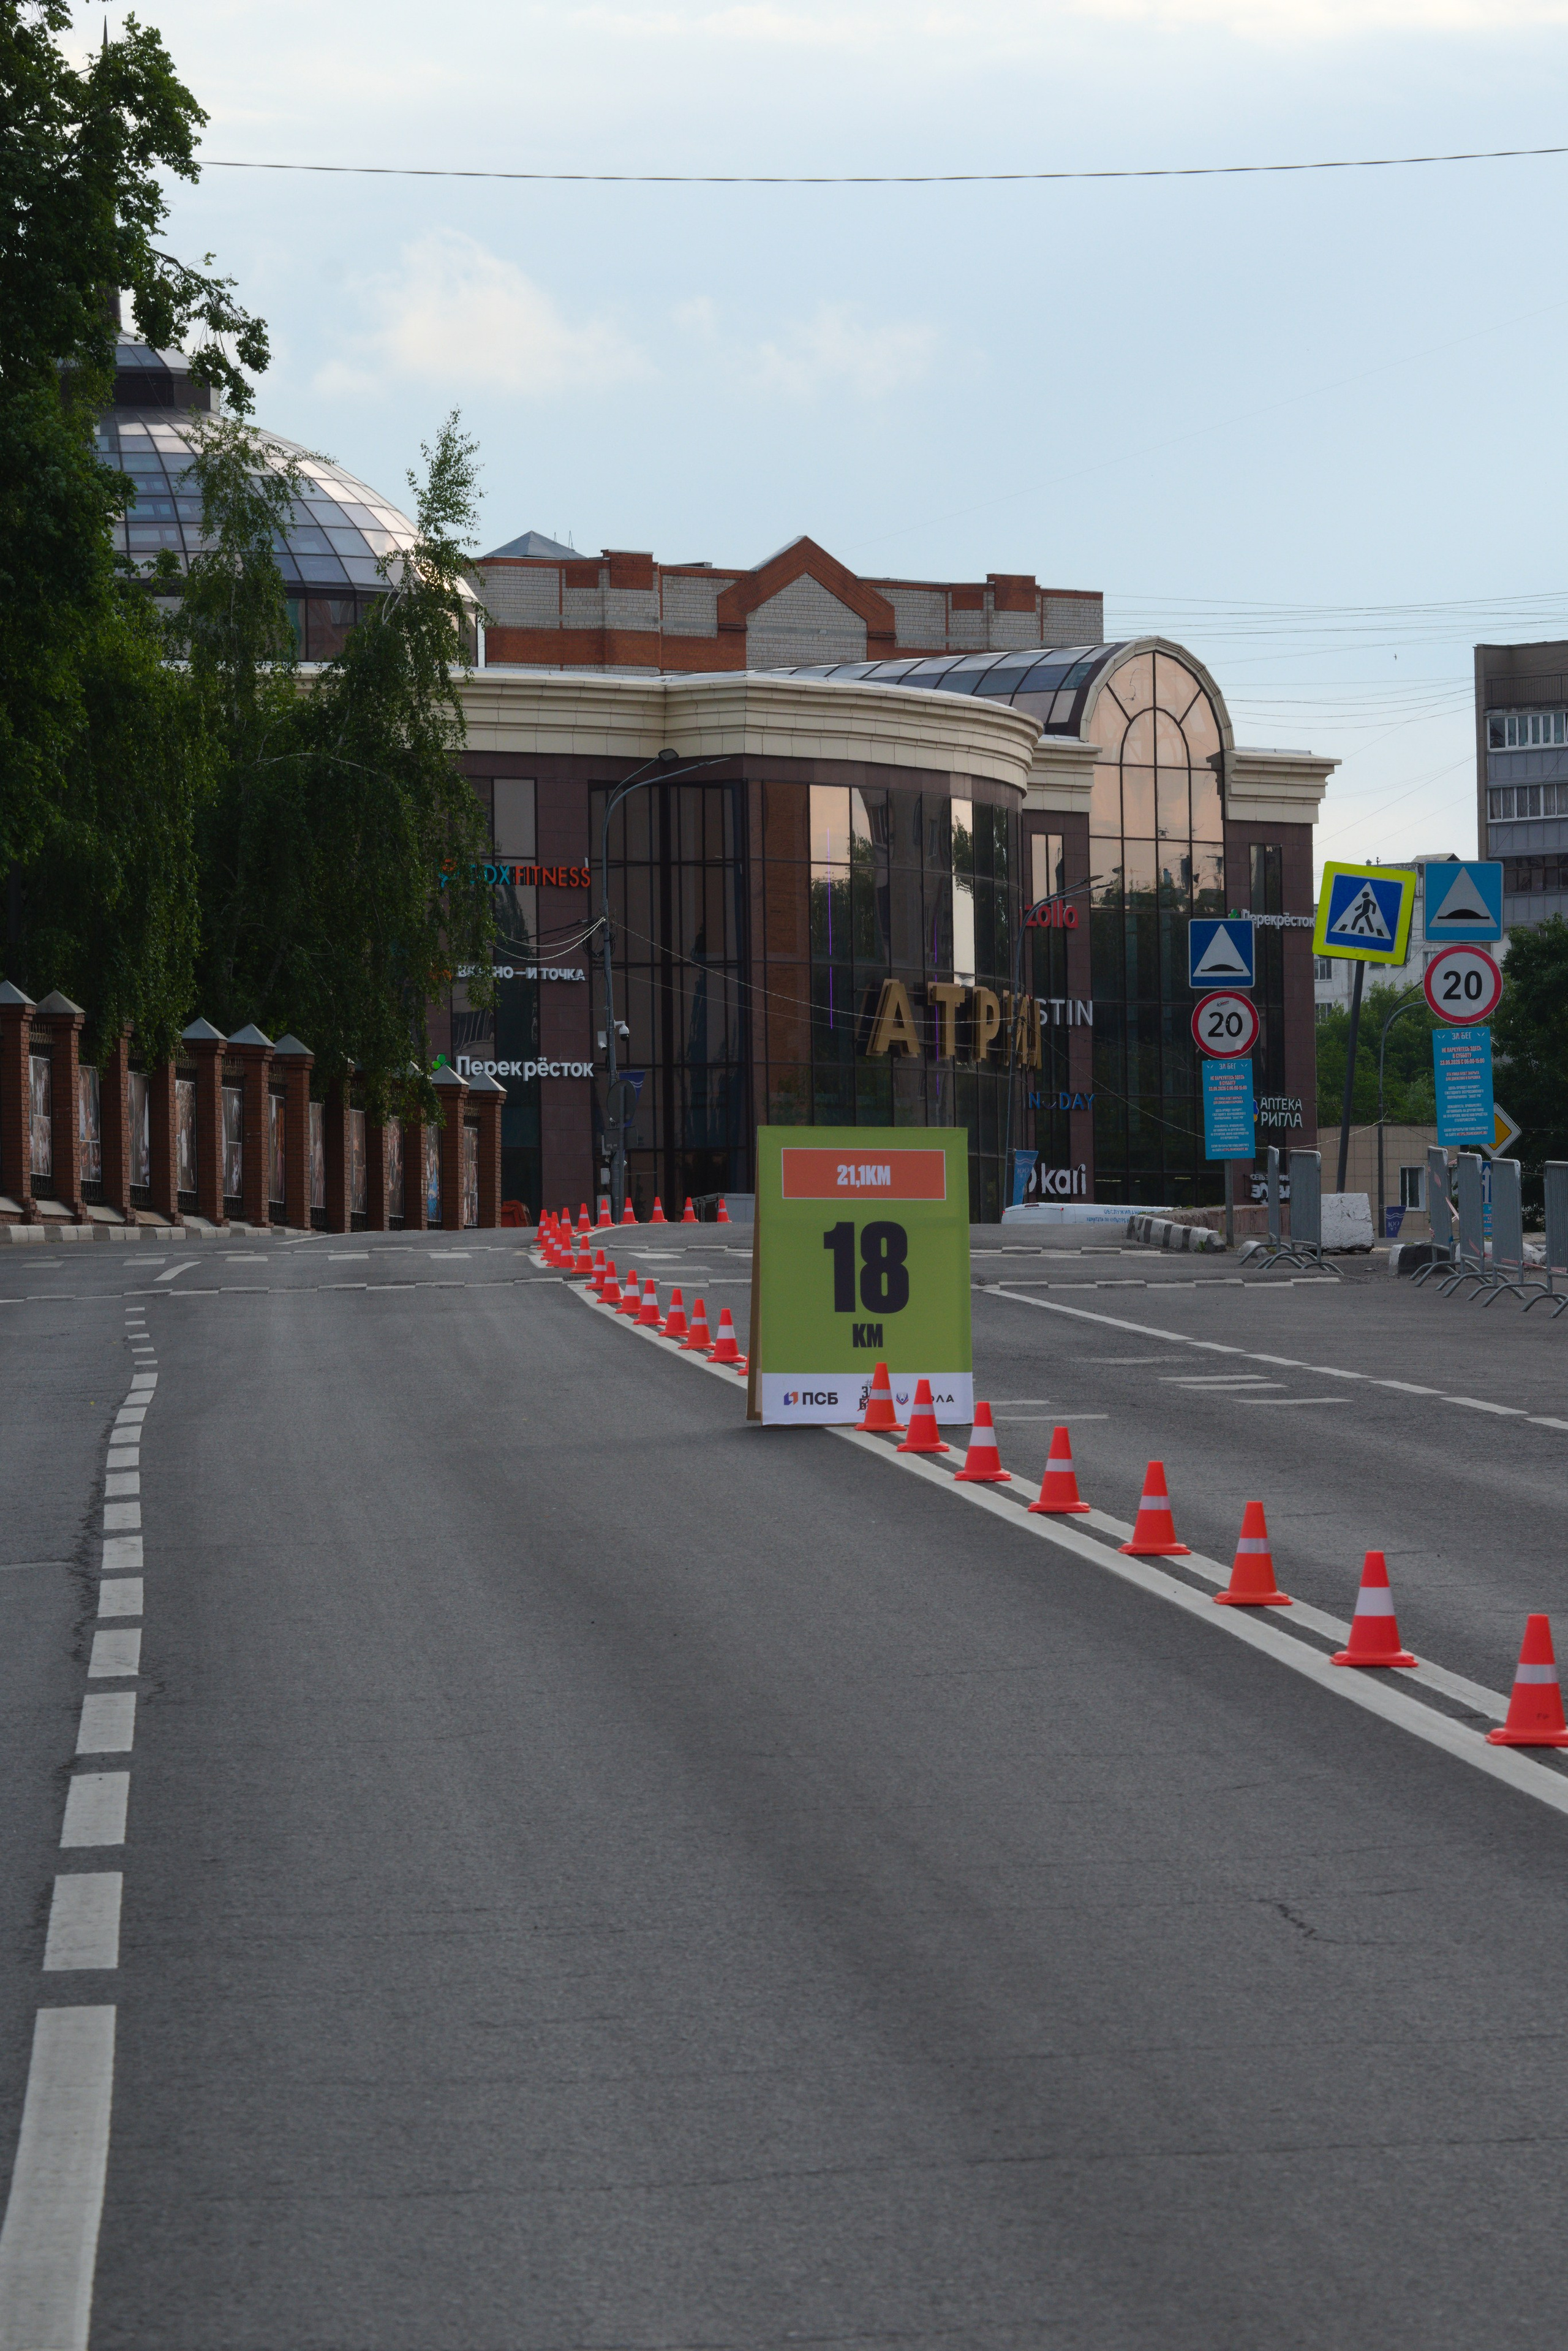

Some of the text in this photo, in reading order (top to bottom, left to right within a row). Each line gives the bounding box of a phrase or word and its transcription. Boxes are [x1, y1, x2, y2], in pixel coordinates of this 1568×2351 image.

[515, 865, 591, 888] FITNESS
[1025, 896, 1079, 928] zolla
[1241, 909, 1315, 929] Перекрёсток
[538, 967, 586, 981] ТОЧКА
[1442, 970, 1483, 1000] 20
[1035, 998, 1093, 1026] STIN
[1208, 1012, 1243, 1037] 20
[456, 1055, 594, 1082] Перекрёсток
[1260, 1097, 1303, 1111] АПТЕКА
[1261, 1112, 1303, 1128] РИГЛА
[837, 1165, 891, 1188] 21,1КМ
[1041, 1163, 1086, 1194] kari
[823, 1220, 910, 1314] 18
[852, 1323, 883, 1348] КМ
[802, 1392, 839, 1405] ПСБ
